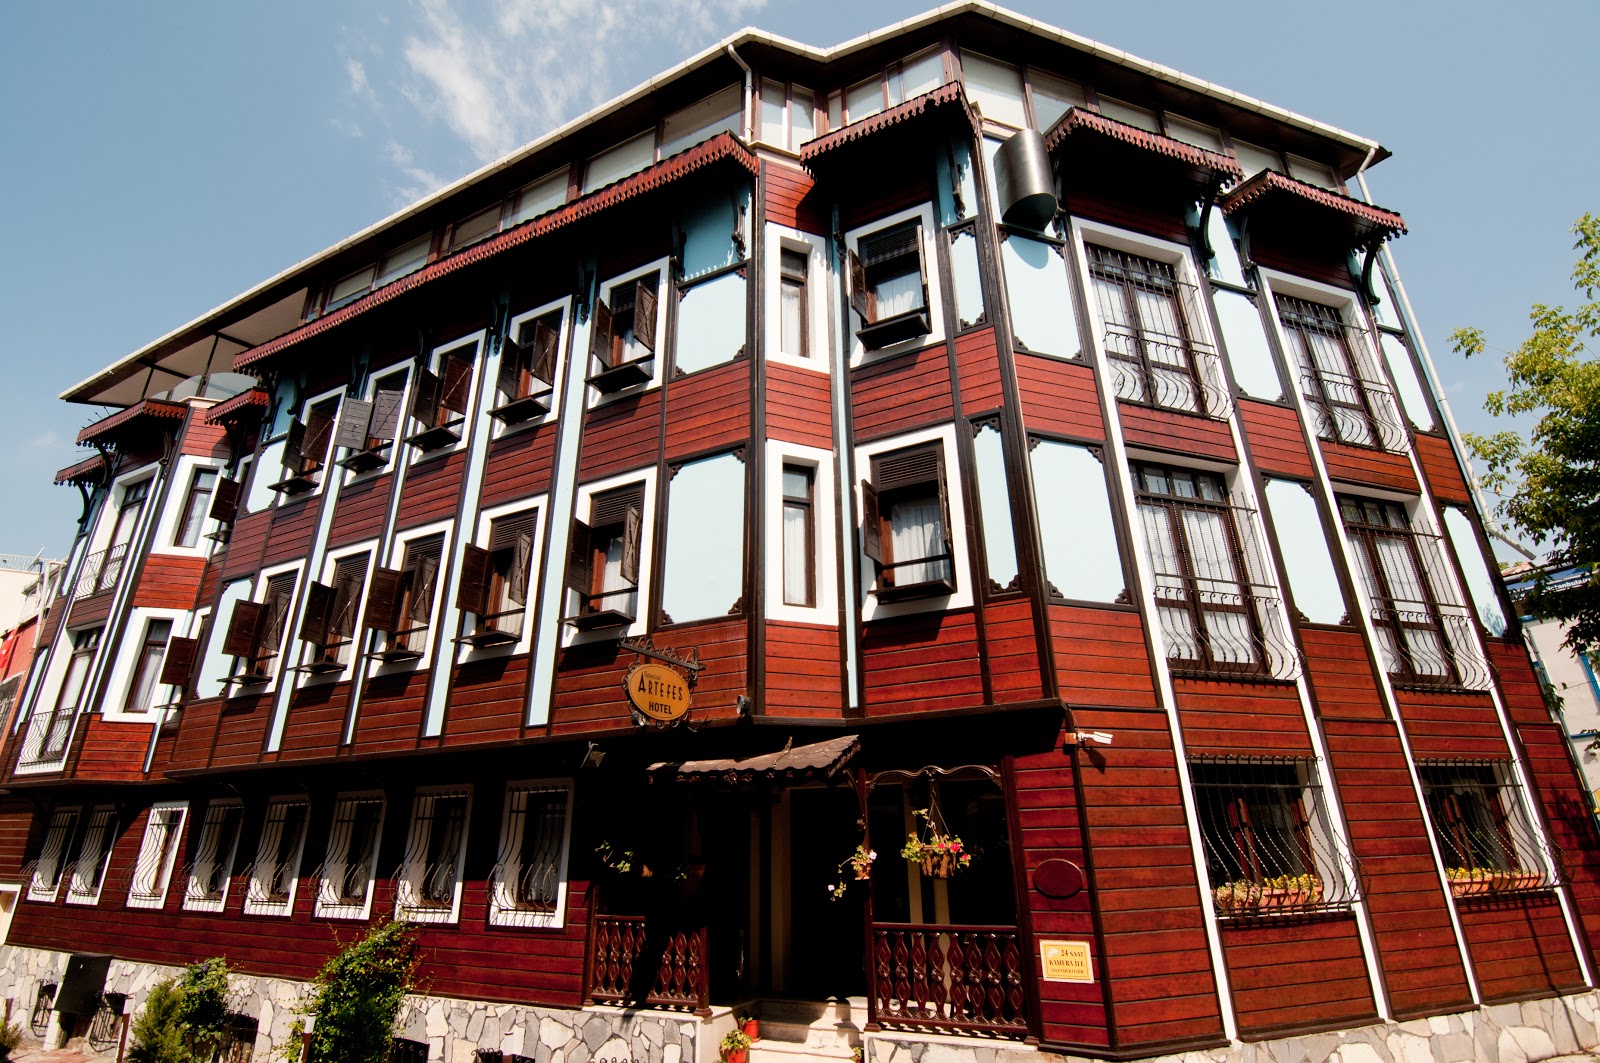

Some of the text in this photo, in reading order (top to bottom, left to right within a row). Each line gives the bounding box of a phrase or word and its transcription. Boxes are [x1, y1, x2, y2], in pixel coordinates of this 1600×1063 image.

[638, 671, 683, 701] ARTEFES
[649, 701, 672, 715] HOTEL
[1061, 949, 1069, 957] 24
[1049, 959, 1073, 967] KAMERA
